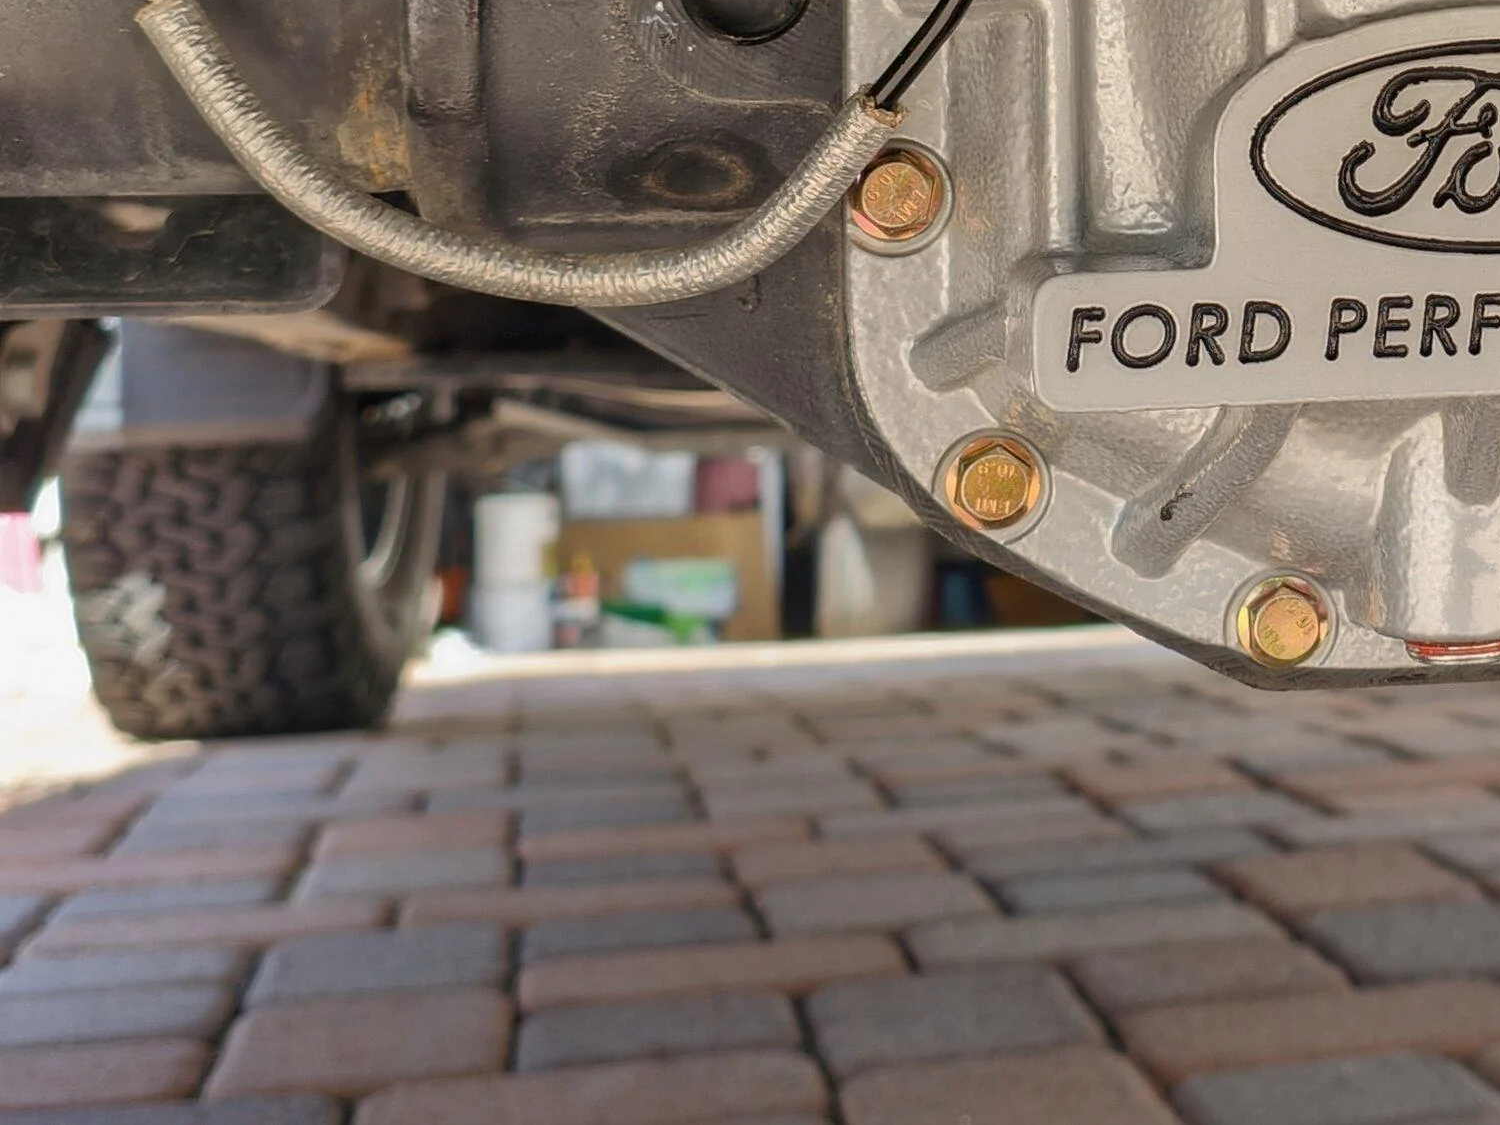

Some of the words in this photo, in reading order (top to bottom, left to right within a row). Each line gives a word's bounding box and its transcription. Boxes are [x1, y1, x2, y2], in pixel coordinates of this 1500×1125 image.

[1065, 300, 1293, 373] FORD
[977, 461, 1016, 479] 10.9
[975, 497, 1012, 515] FMI
